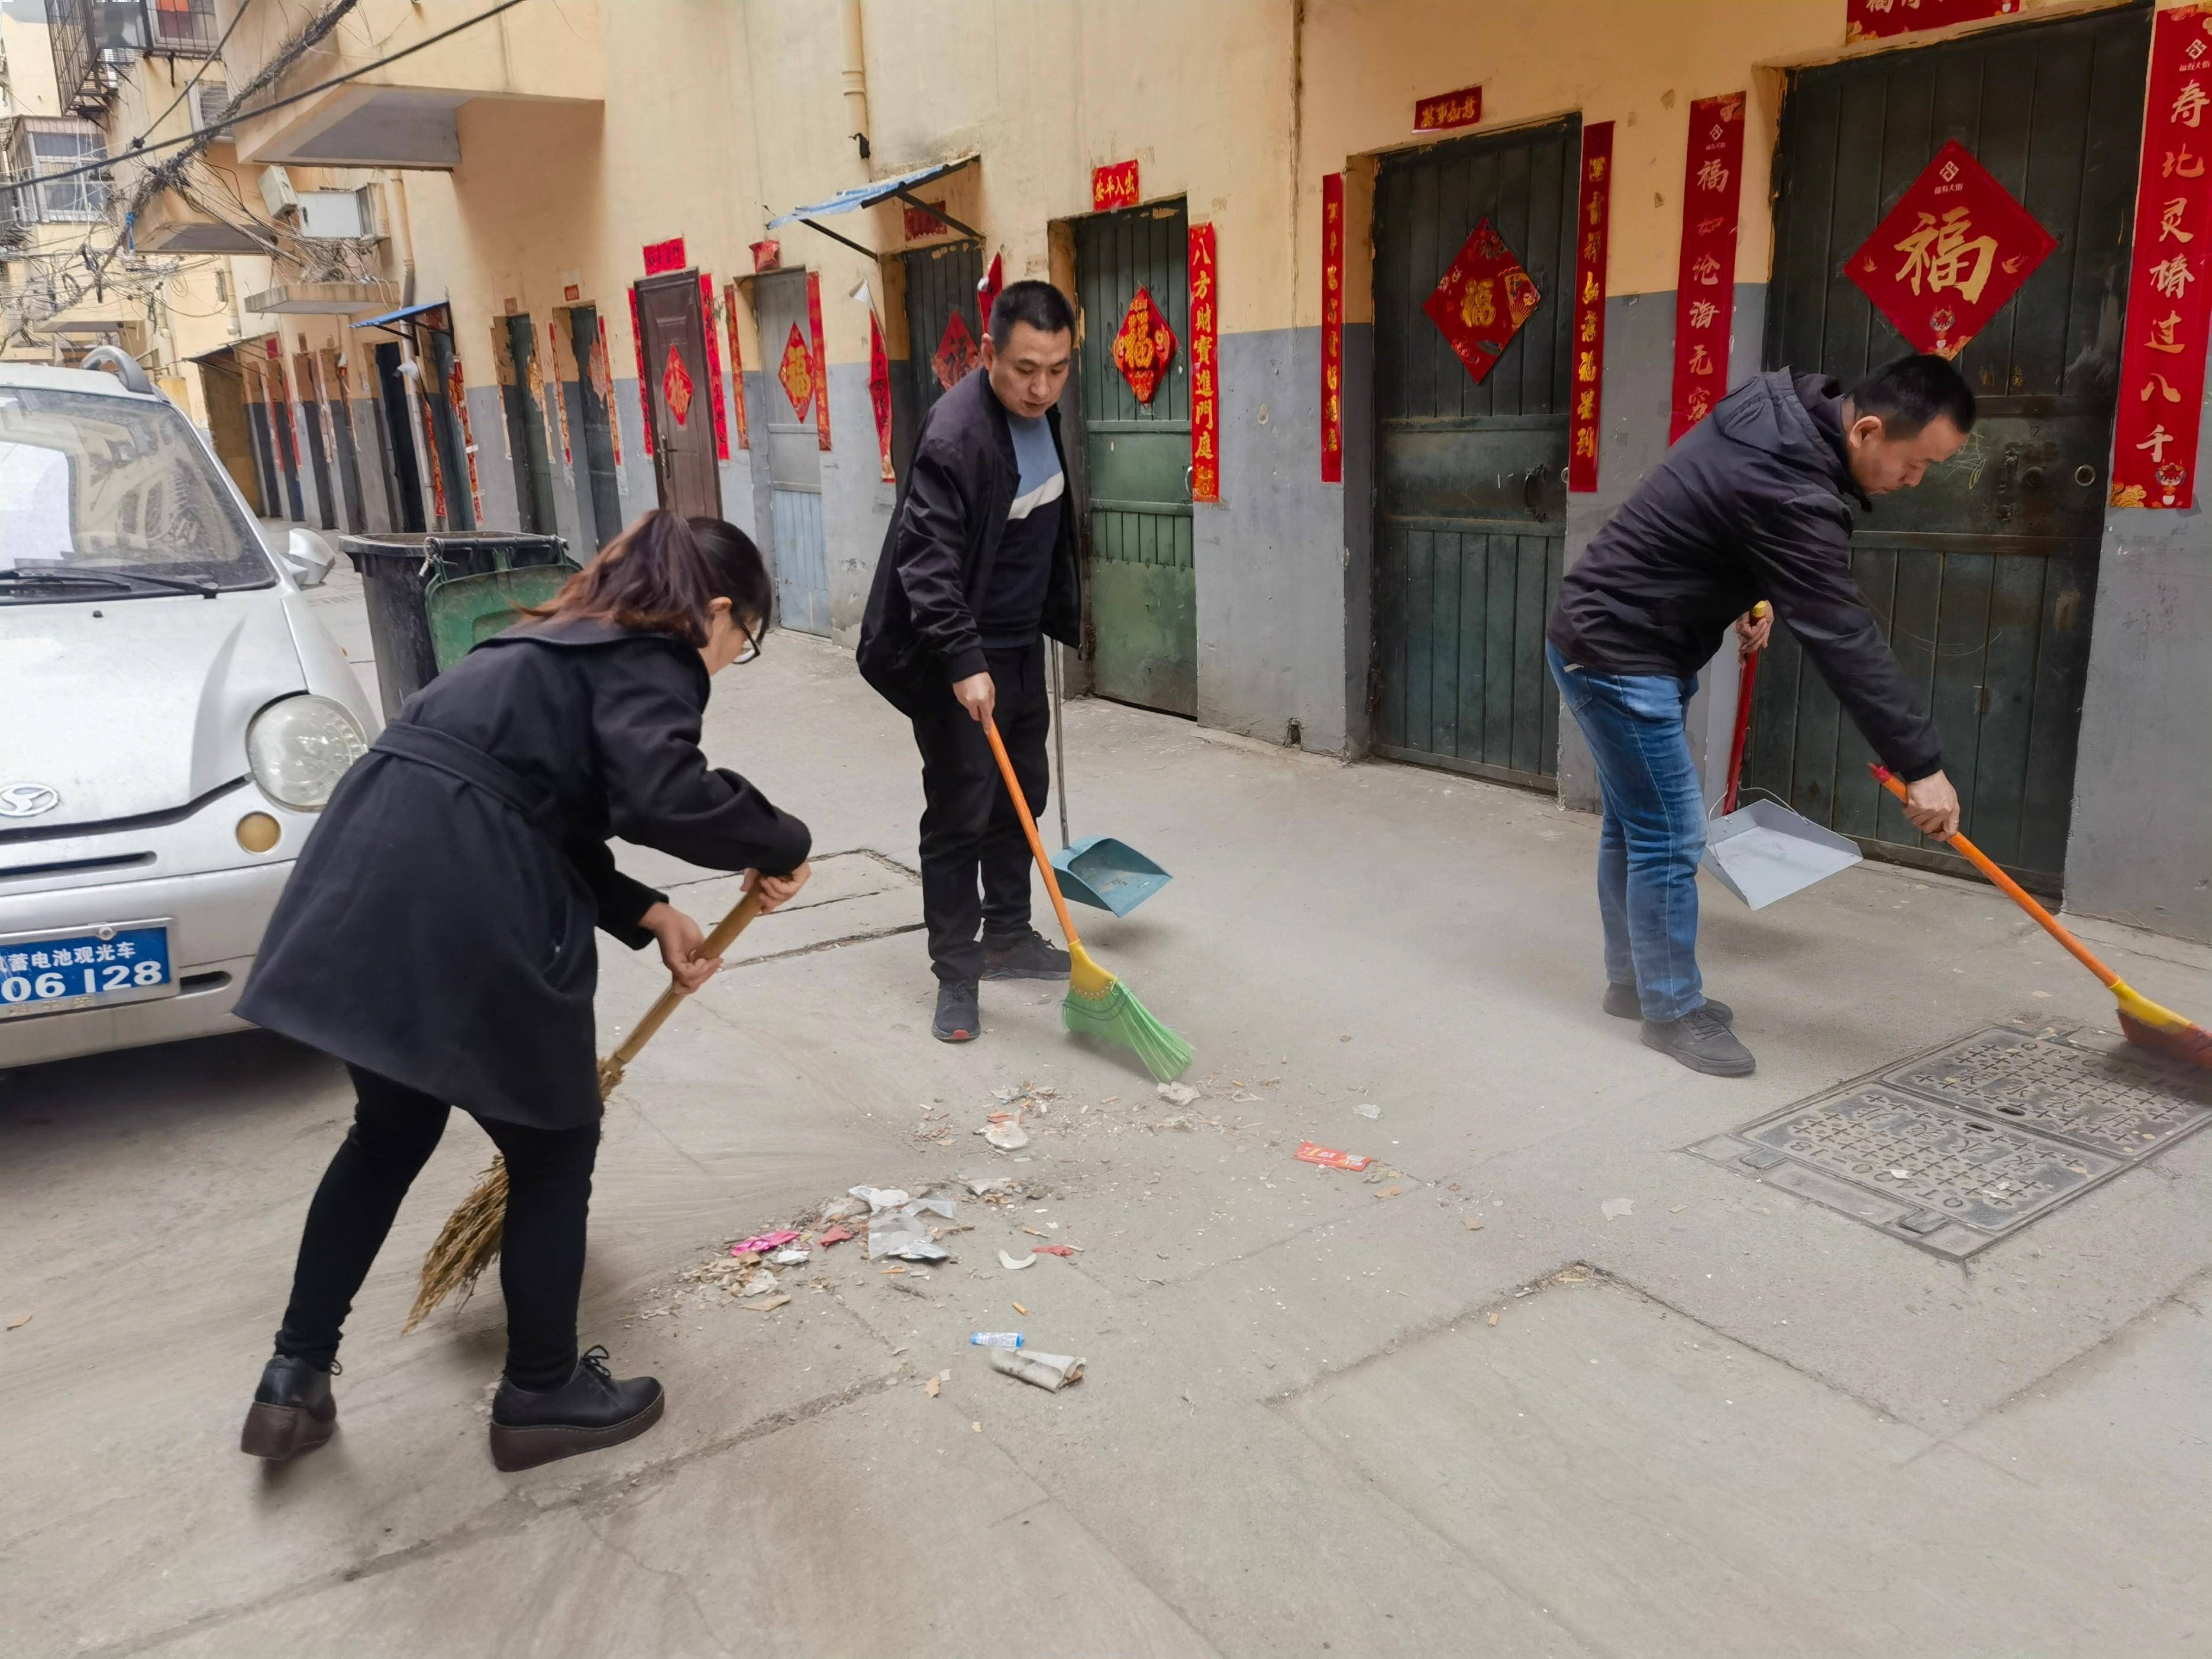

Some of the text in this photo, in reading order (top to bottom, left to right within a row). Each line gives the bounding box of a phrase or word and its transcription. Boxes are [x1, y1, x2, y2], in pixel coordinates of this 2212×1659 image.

[1687, 158, 1729, 421] 福如沧海无穷
[1894, 206, 1998, 305] 福
[2136, 79, 2210, 463] 寿比灵椿过八千
[1124, 311, 1154, 368] 福
[1461, 277, 1496, 328] 福
[787, 346, 811, 398] 福
[1193, 237, 1214, 459] 八方財寶進門庭
[2, 961, 162, 1002] 06 128
